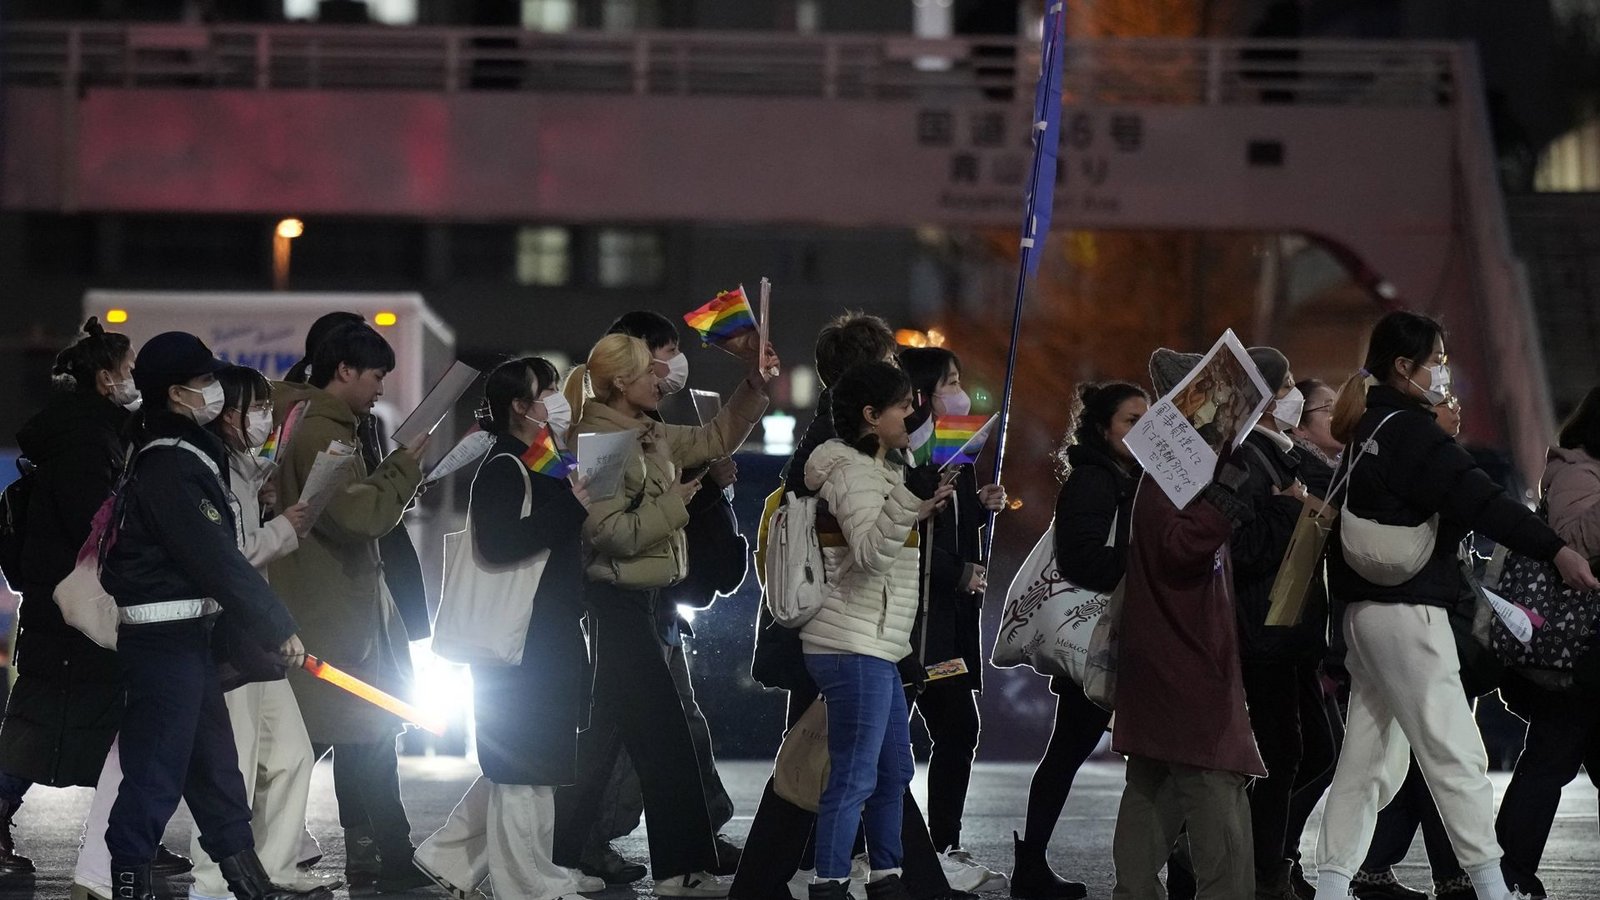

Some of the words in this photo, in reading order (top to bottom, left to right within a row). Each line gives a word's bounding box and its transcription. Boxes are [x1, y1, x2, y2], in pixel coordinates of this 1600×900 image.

[916, 110, 1143, 152] 国道6号
[952, 153, 1107, 186] 青山り
